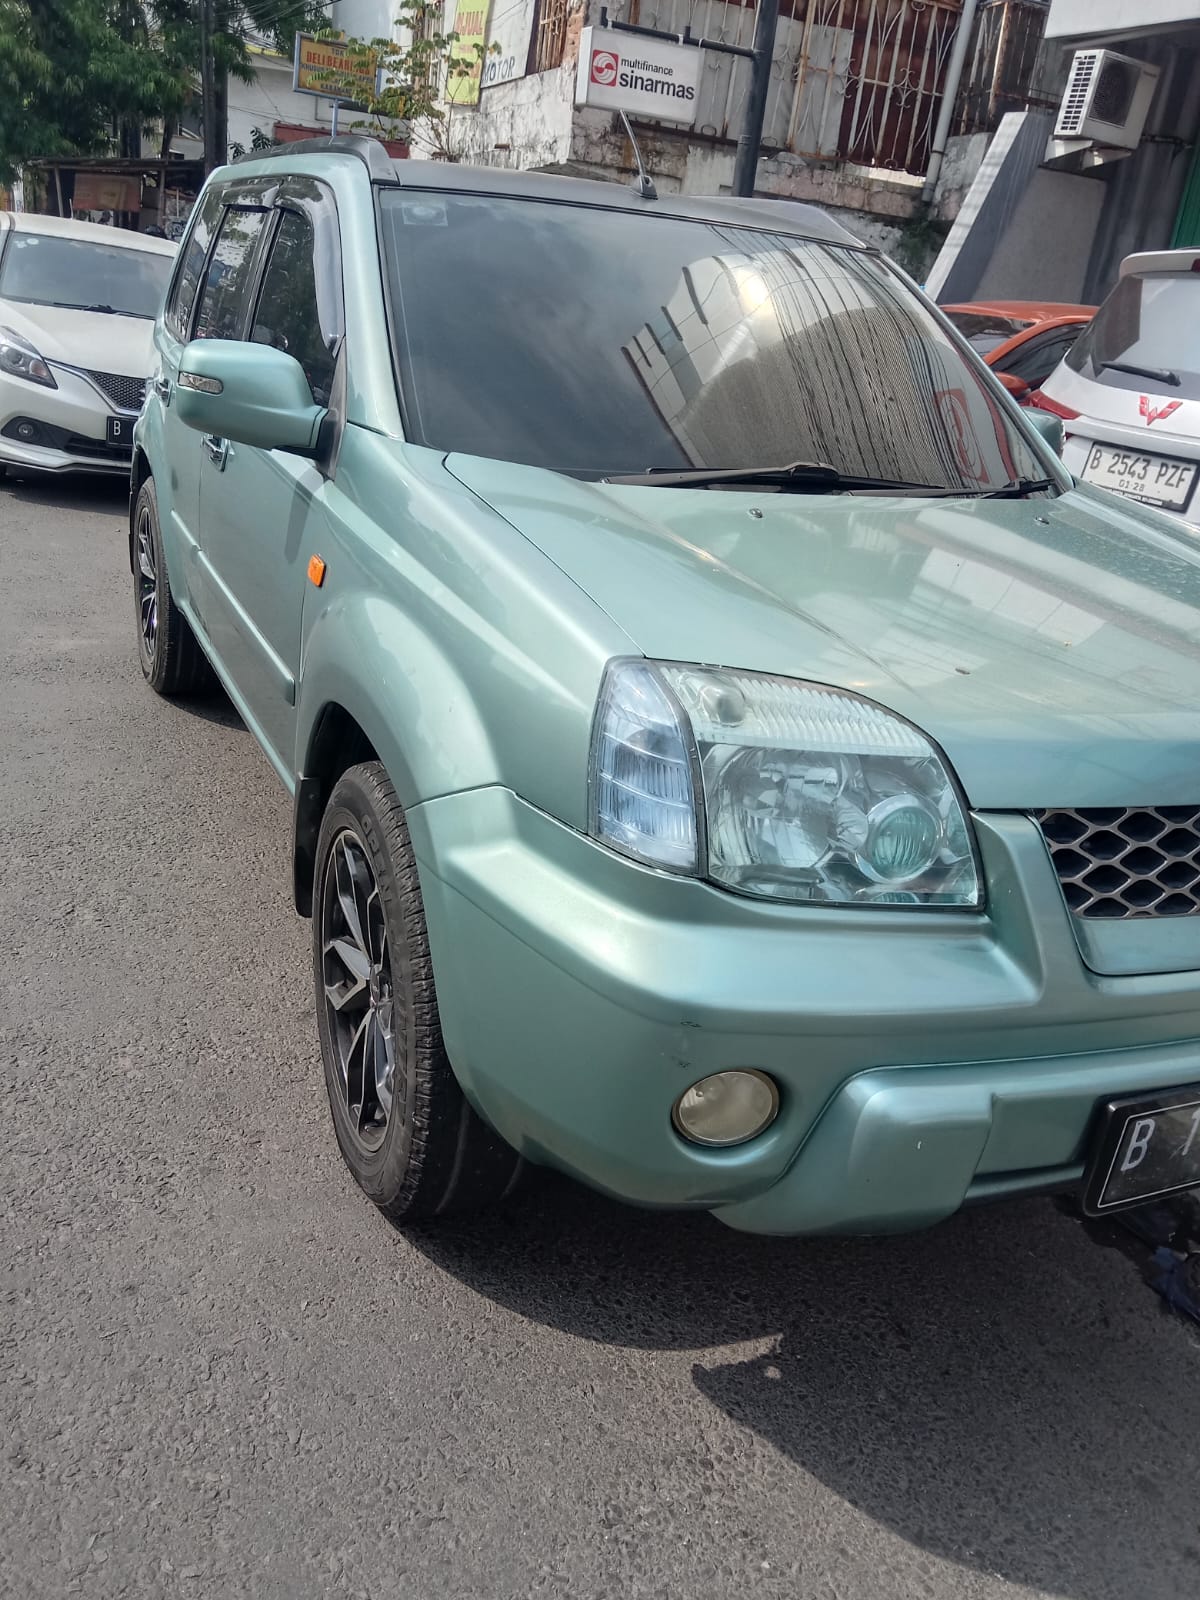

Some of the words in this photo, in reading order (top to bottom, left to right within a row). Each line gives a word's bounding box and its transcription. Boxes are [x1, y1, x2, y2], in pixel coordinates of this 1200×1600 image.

[482, 56, 515, 83] MOTOR
[621, 58, 674, 76] multifinance
[619, 70, 695, 100] sinarmas
[113, 420, 121, 436] B
[1089, 449, 1103, 470] B
[1107, 453, 1152, 480] 2543
[1154, 461, 1192, 489] PZF
[1120, 1118, 1156, 1172] B
